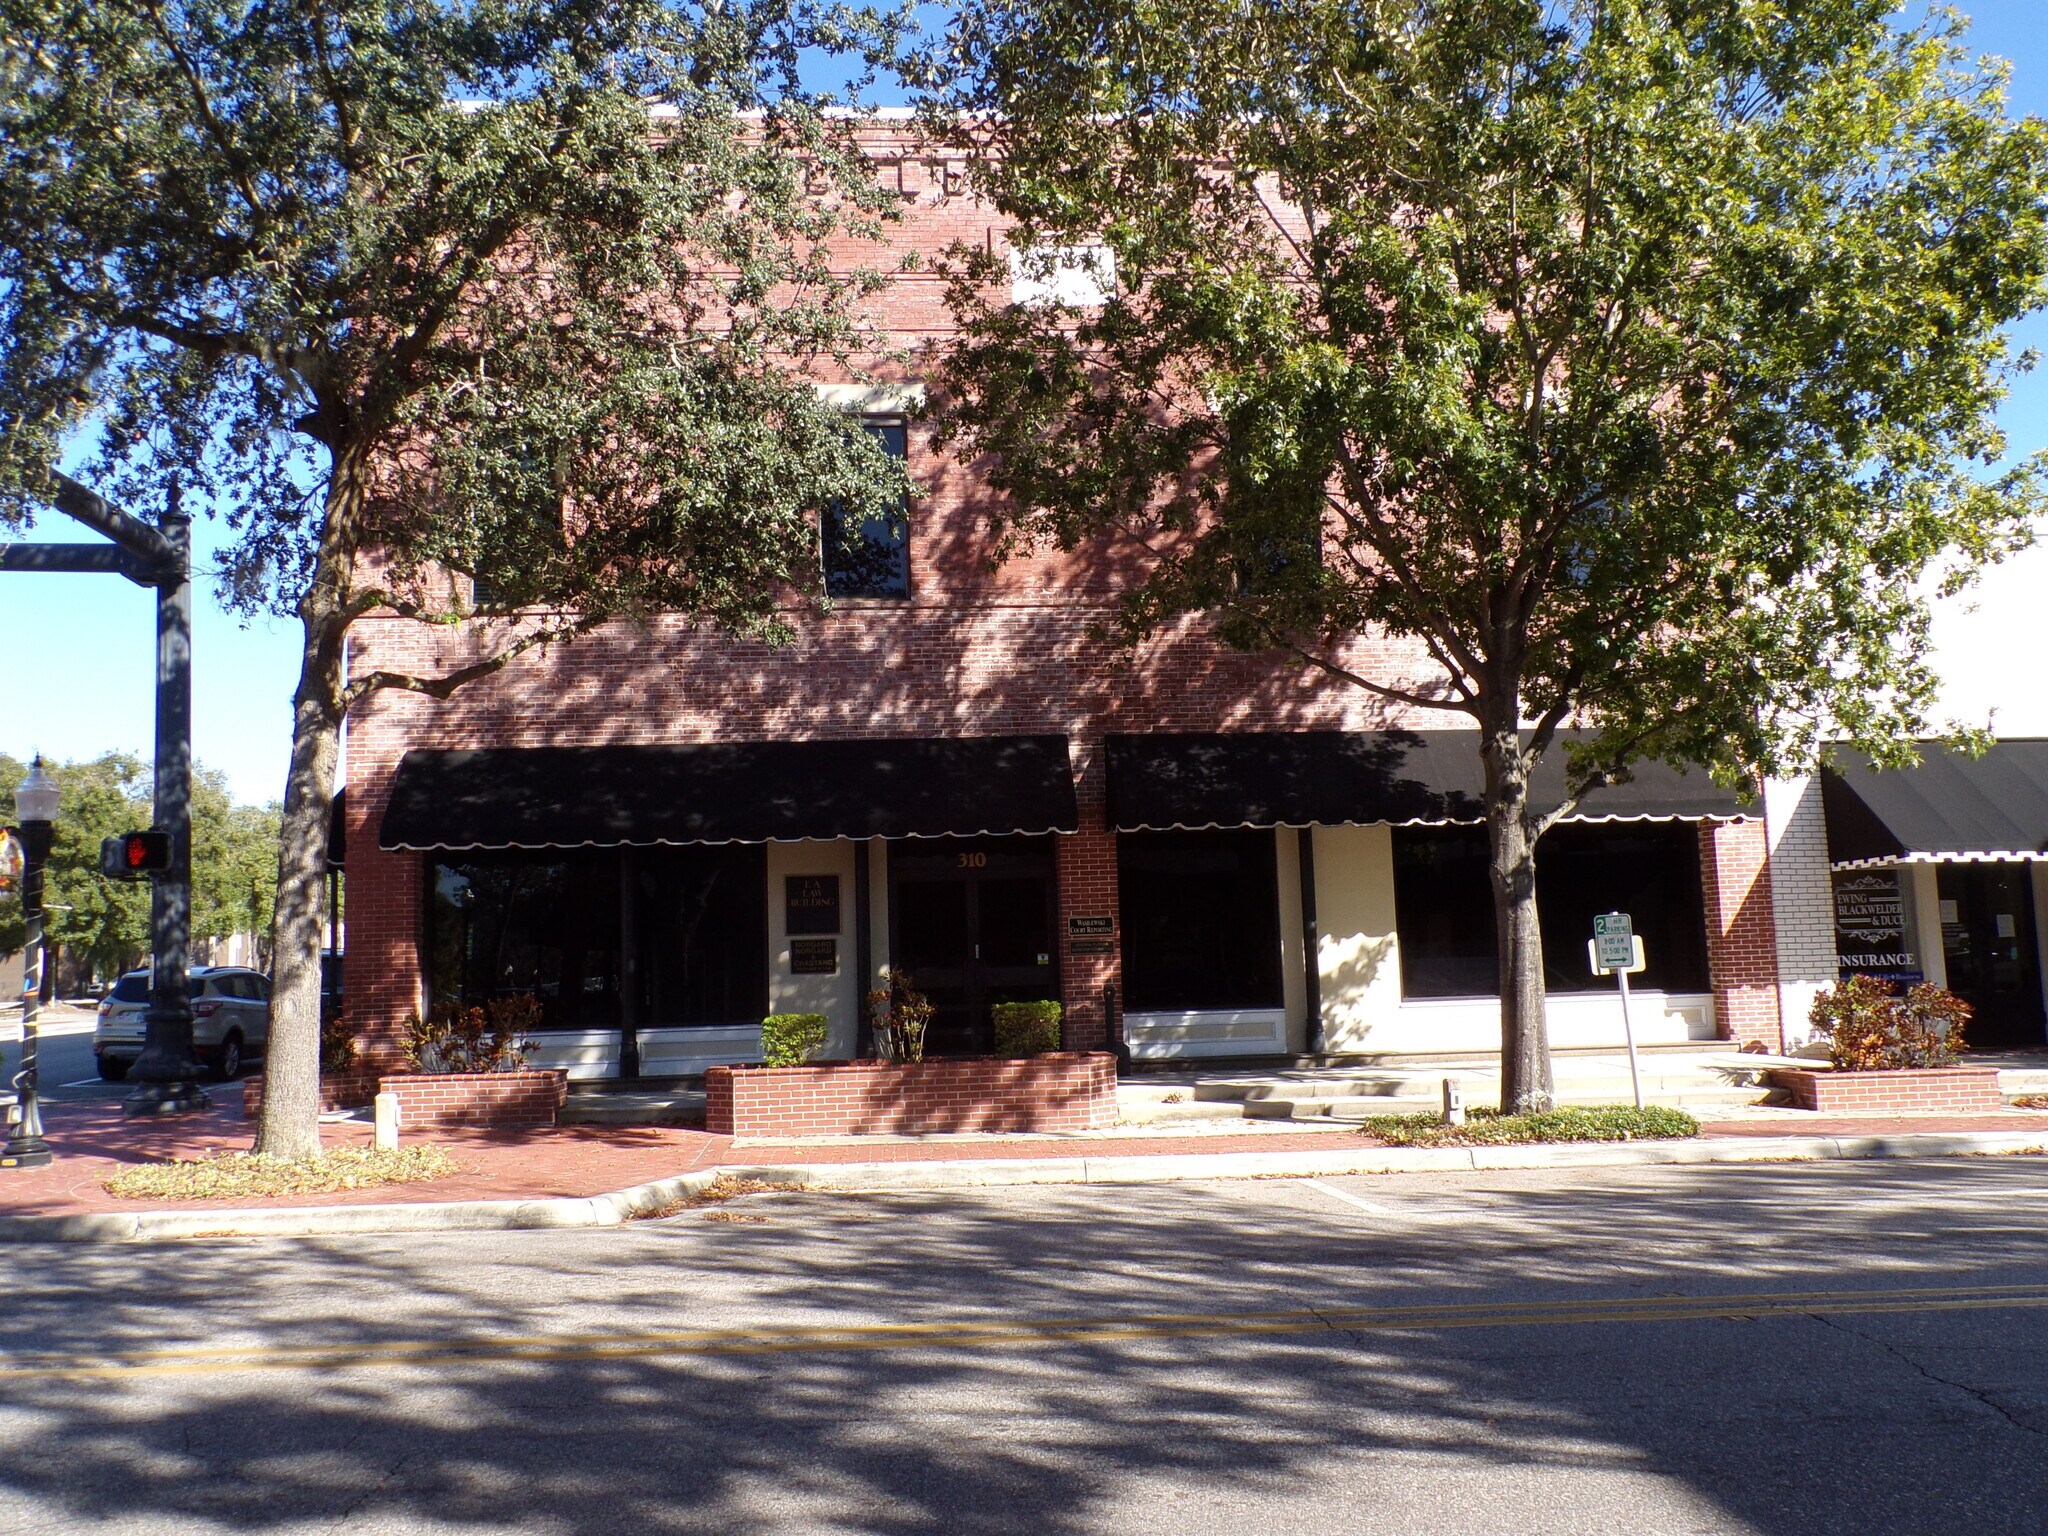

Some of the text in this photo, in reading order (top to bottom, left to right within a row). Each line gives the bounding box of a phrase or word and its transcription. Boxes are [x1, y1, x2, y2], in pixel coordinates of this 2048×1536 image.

[957, 852, 987, 868] 310
[803, 889, 822, 898] LAW
[1837, 893, 1867, 904] EWING
[790, 898, 835, 908] BUILDING
[1838, 904, 1904, 915] BLACKWELDER
[1596, 917, 1622, 932] 2 HR
[1872, 916, 1880, 926] &
[1616, 937, 1625, 945] AM
[1837, 953, 1916, 967] INSURANCE
